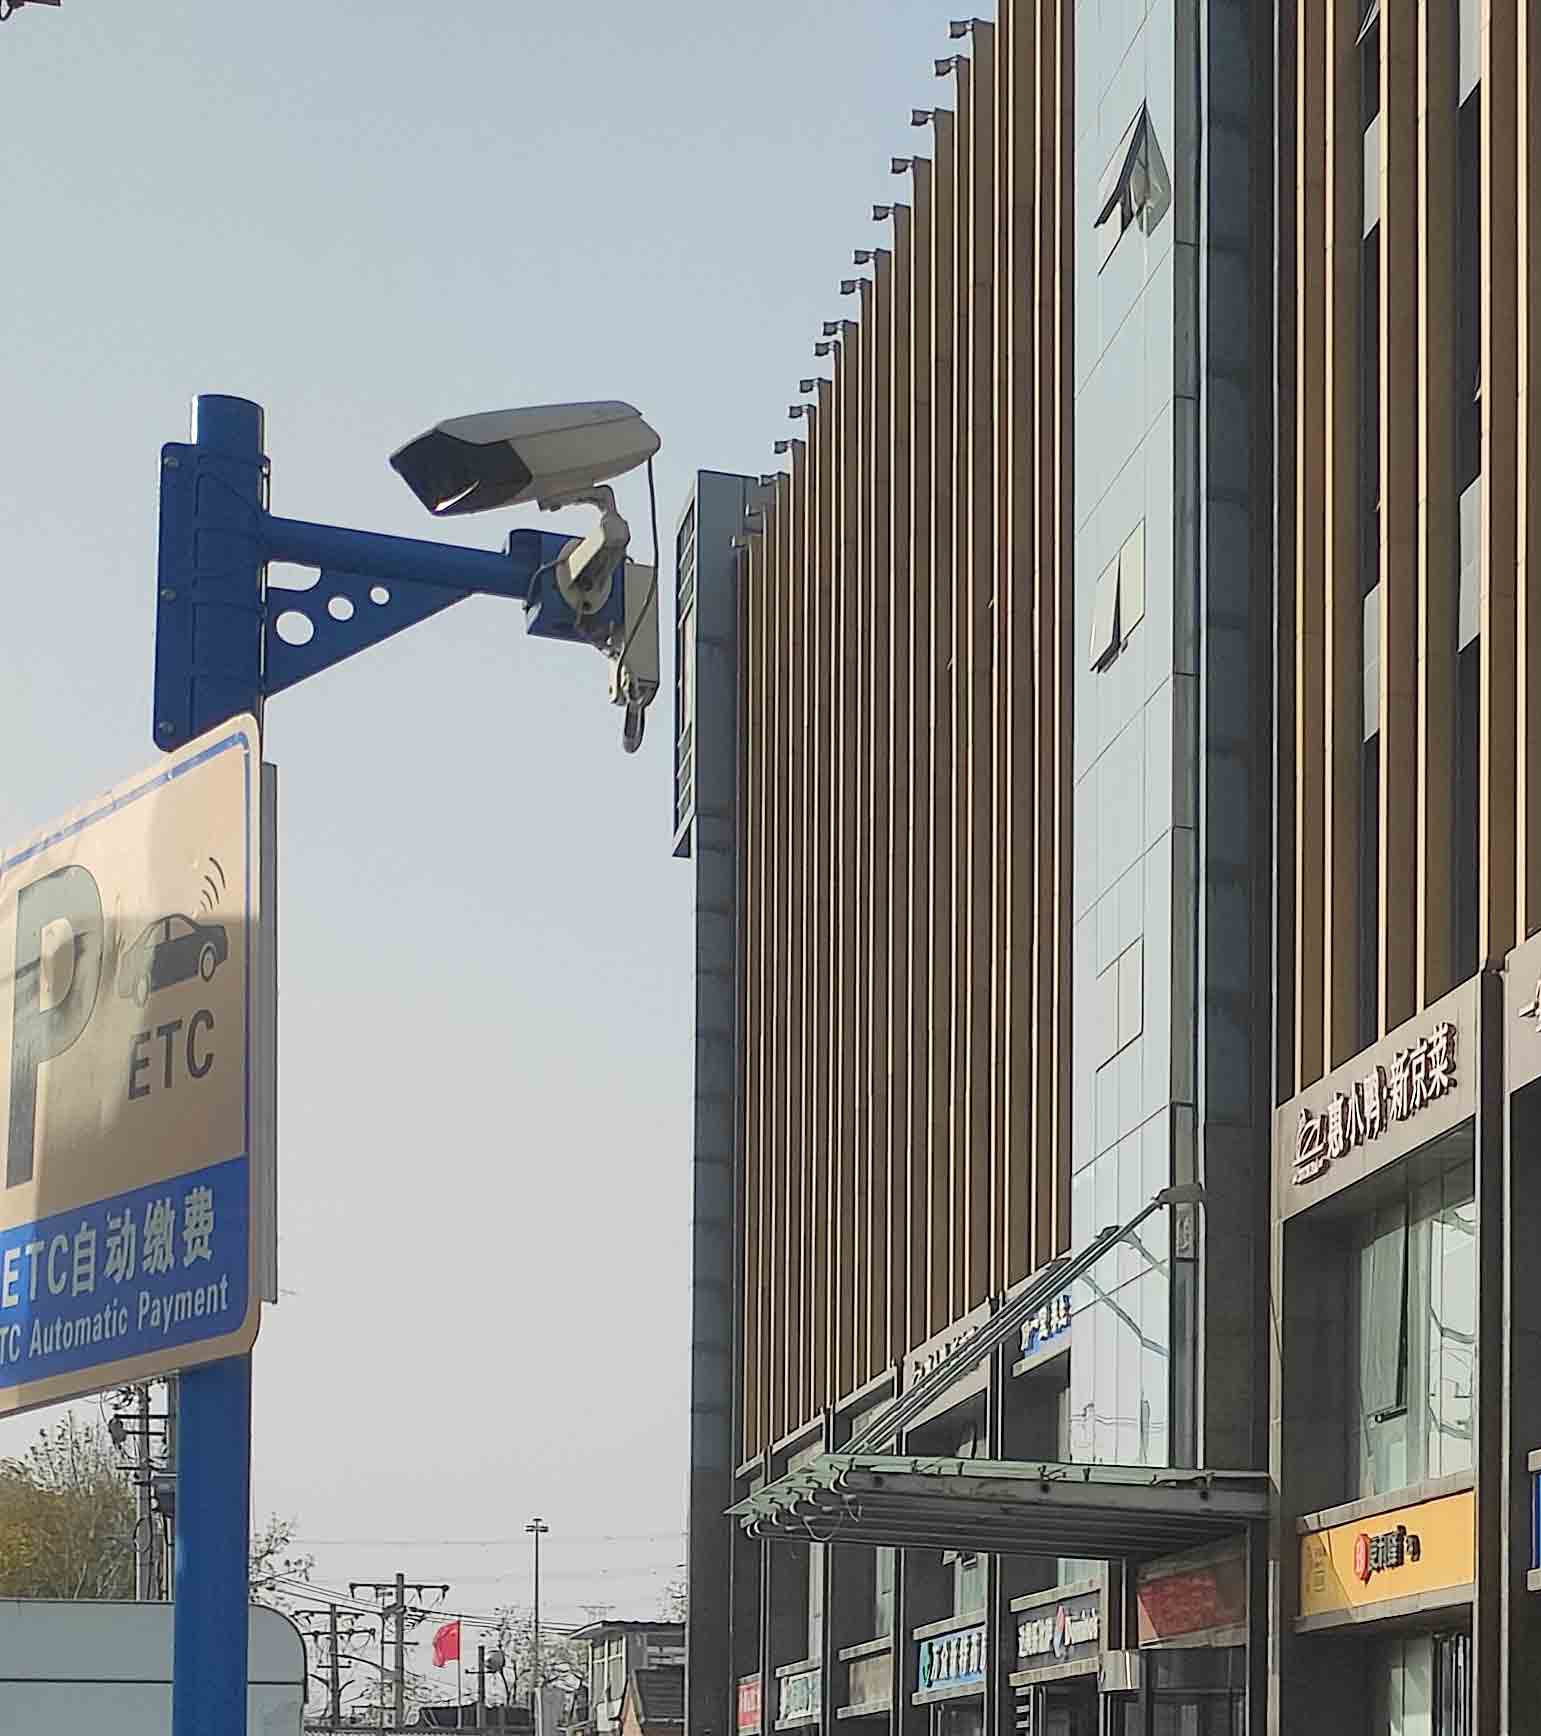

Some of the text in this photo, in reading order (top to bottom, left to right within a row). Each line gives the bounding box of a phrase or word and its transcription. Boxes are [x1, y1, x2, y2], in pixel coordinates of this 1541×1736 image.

[128, 1009, 214, 1100] ETC
[1, 1186, 216, 1308] ETC自动缴费
[29, 1297, 128, 1358] Automatic
[138, 1273, 229, 1331] Payment
